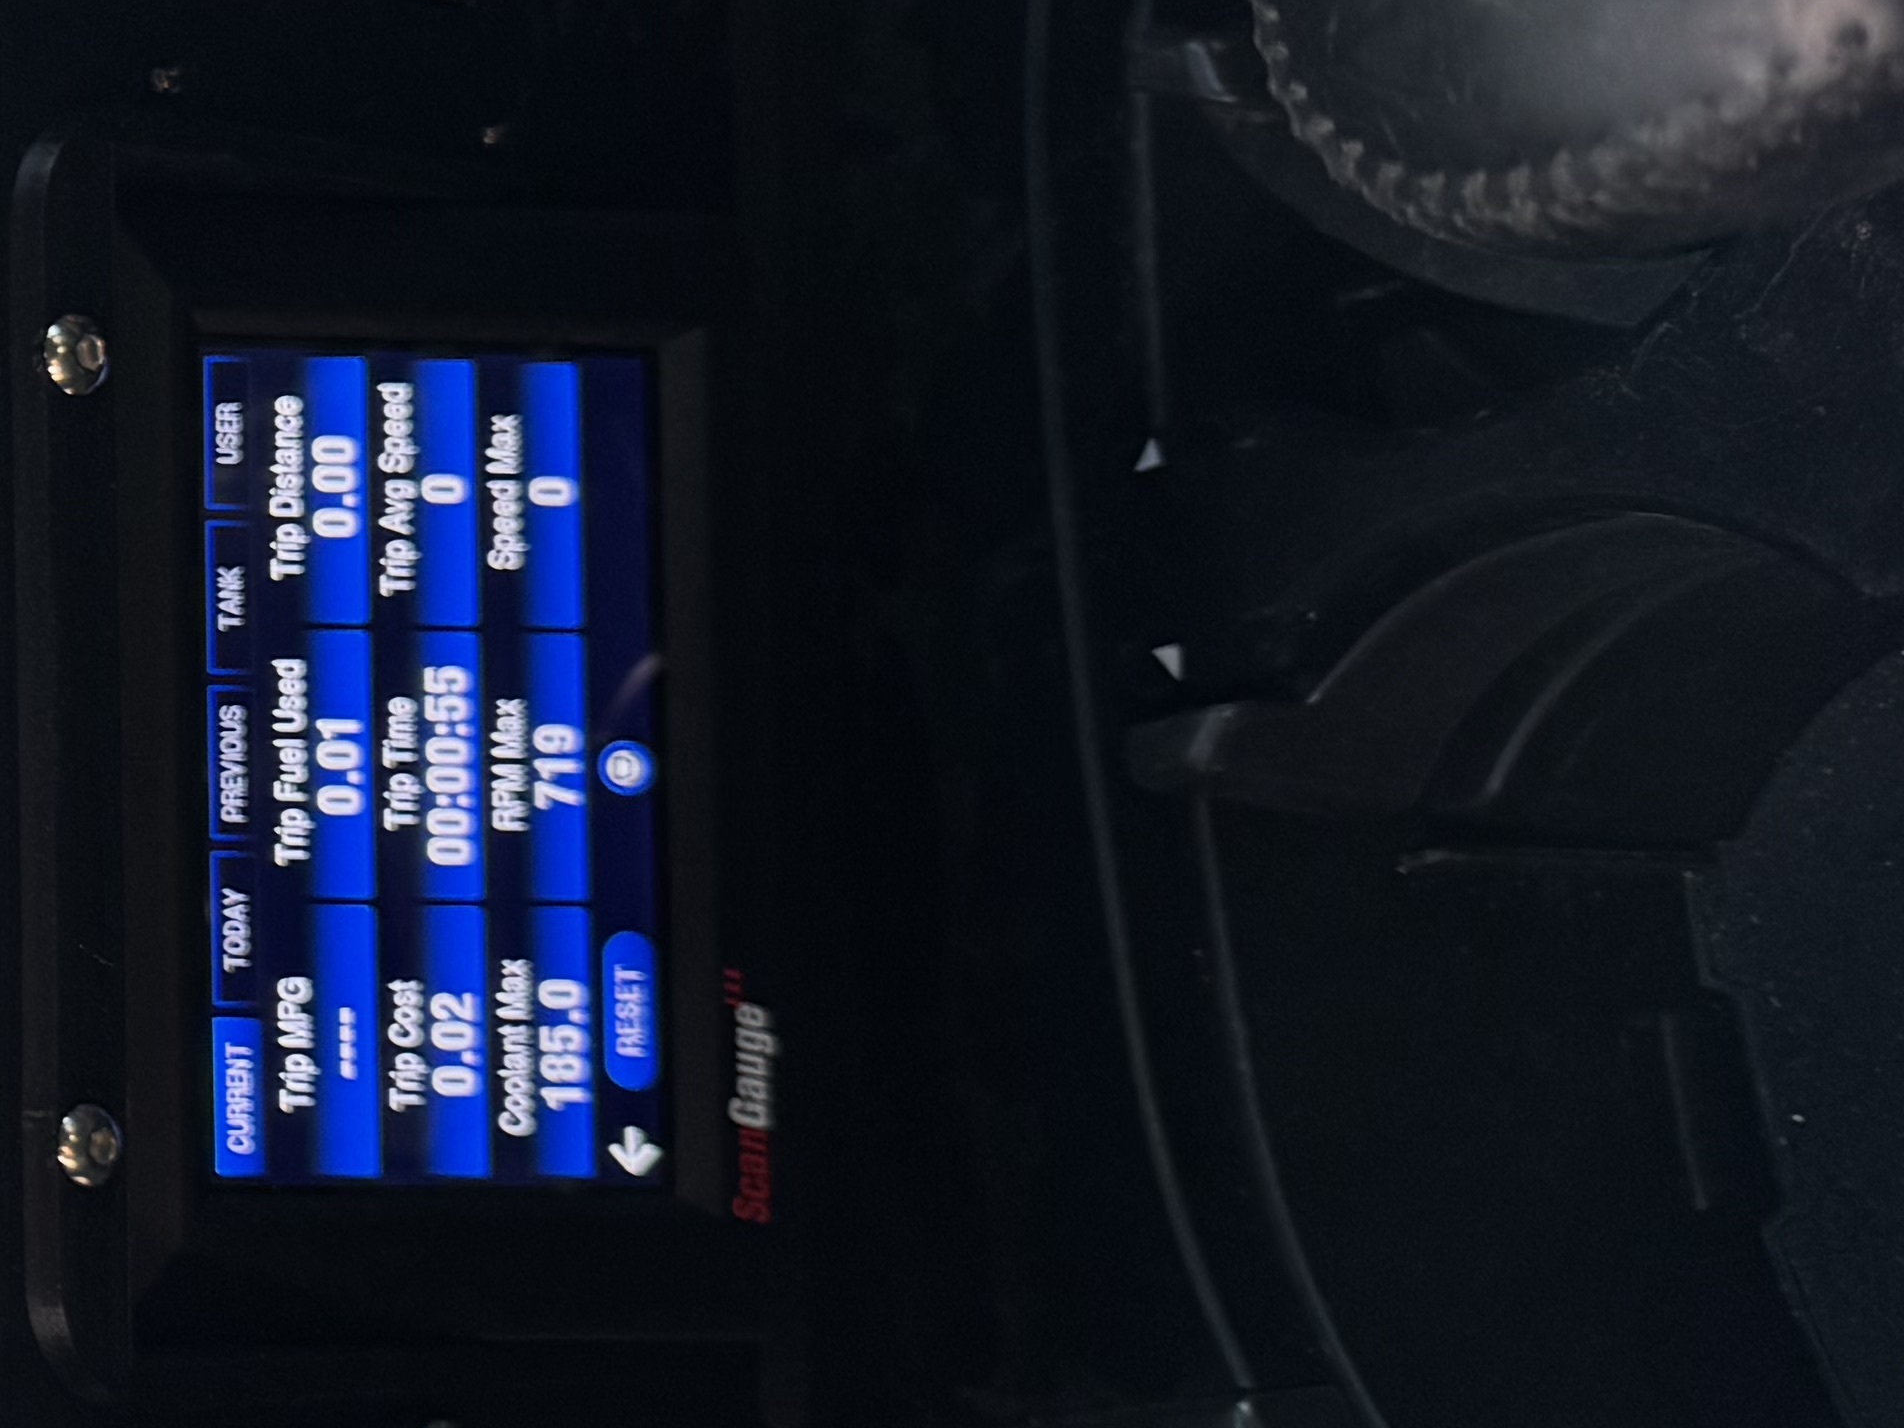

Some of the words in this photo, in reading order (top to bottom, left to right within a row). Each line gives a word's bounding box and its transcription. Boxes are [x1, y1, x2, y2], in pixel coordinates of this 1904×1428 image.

[214, 402, 244, 465] USER
[268, 394, 306, 518] Distance
[376, 381, 421, 474] Speed
[484, 413, 524, 474] Max
[310, 434, 363, 539] 0.00
[377, 478, 420, 536] Avg
[420, 473, 472, 505] 0
[527, 476, 580, 507] 0
[269, 523, 312, 582] Trip
[485, 479, 533, 571] Speed
[215, 565, 246, 633] TANK
[378, 538, 423, 598] Trip
[270, 658, 309, 733] Used
[489, 698, 529, 759] Max
[218, 704, 250, 823] PREVIOUS
[315, 717, 367, 817] 0.01
[381, 696, 419, 769] Time
[423, 665, 479, 866] 00:00:55
[532, 723, 587, 810] 719
[271, 738, 310, 802] Fuel
[382, 772, 426, 831] Trip
[490, 763, 531, 832] RPM
[272, 808, 318, 867] Trip
[220, 887, 253, 973] TODAY
[276, 976, 316, 1049] MPG
[386, 978, 426, 1048] Cost
[493, 959, 535, 1020] Max
[614, 963, 651, 1057] RESET
[430, 991, 484, 1098] 0.02
[537, 978, 592, 1111] 185.0
[224, 1042, 256, 1155] CURRENT
[277, 1054, 322, 1114] Trip
[388, 1052, 431, 1112] Trip
[495, 1024, 539, 1137] Coolant
